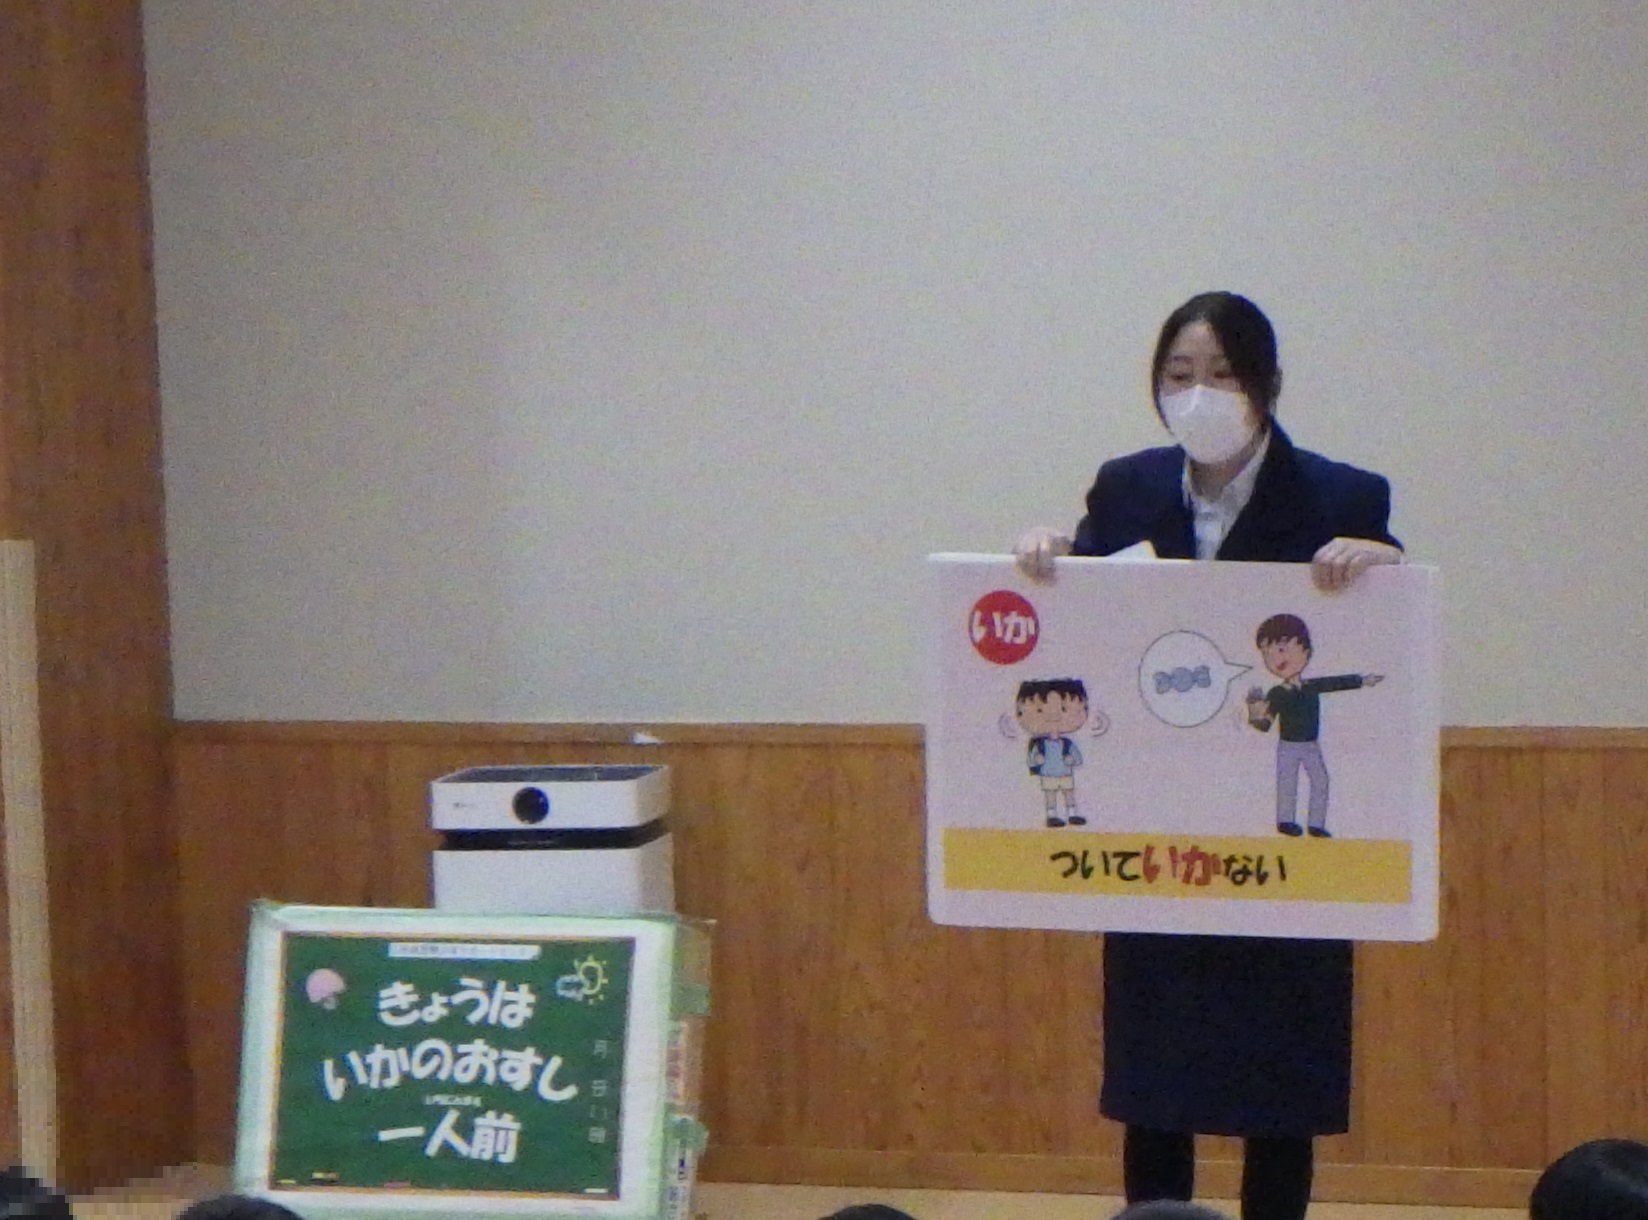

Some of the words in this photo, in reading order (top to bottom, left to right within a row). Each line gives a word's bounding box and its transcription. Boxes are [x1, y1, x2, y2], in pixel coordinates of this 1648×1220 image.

[971, 610, 1036, 643] いか
[1050, 844, 1288, 888] ついていかない
[378, 976, 537, 1029] きょうは
[322, 1037, 579, 1101] いかのおすし
[376, 1108, 522, 1164] 一人前
